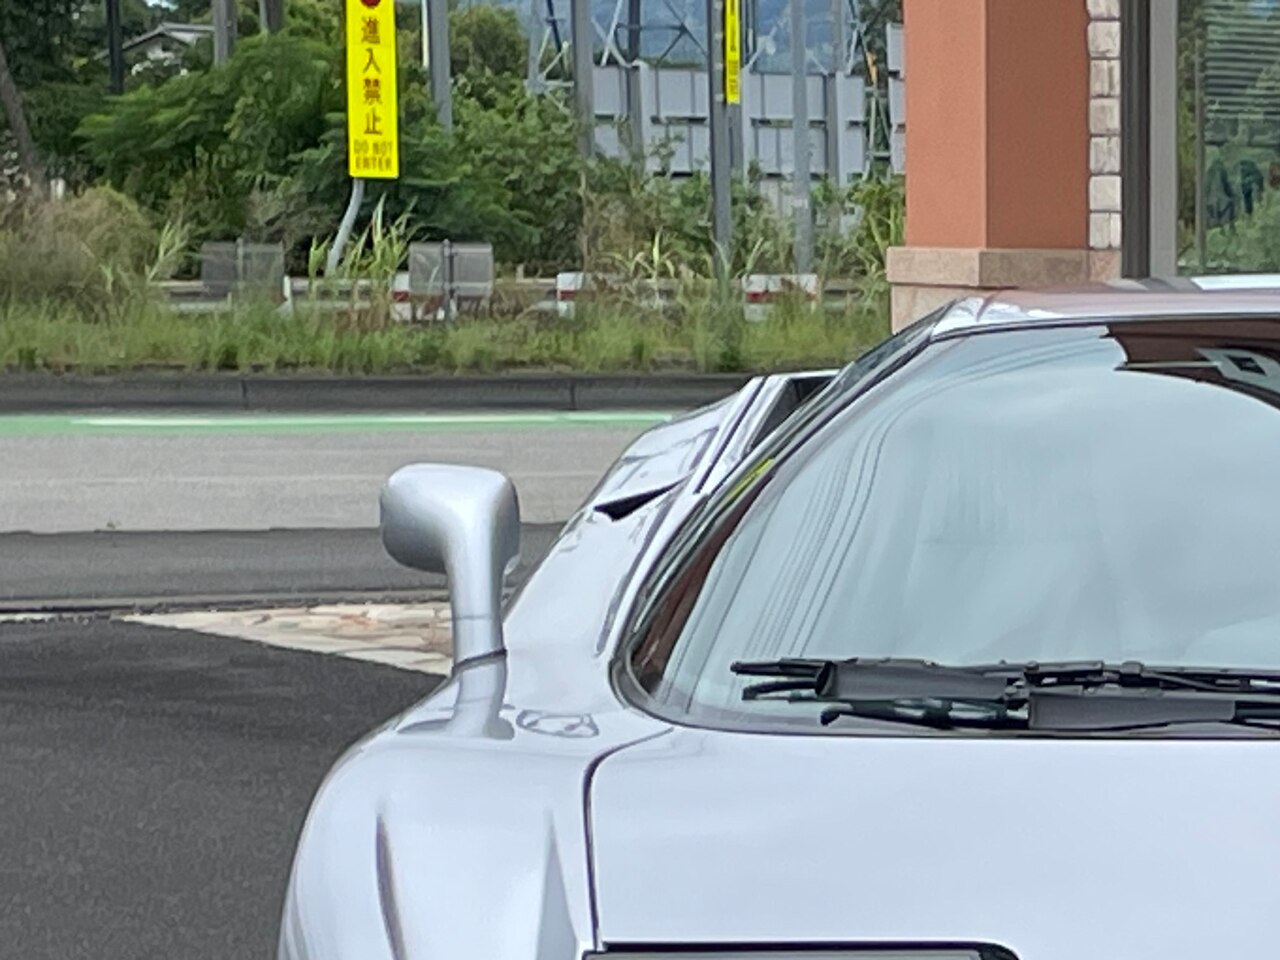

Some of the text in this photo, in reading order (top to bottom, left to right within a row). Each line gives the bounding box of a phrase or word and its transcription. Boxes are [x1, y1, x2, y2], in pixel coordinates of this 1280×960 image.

[361, 17, 382, 135] 進入禁止
[354, 140, 392, 156] DO NOT
[355, 157, 392, 171] ENTER
